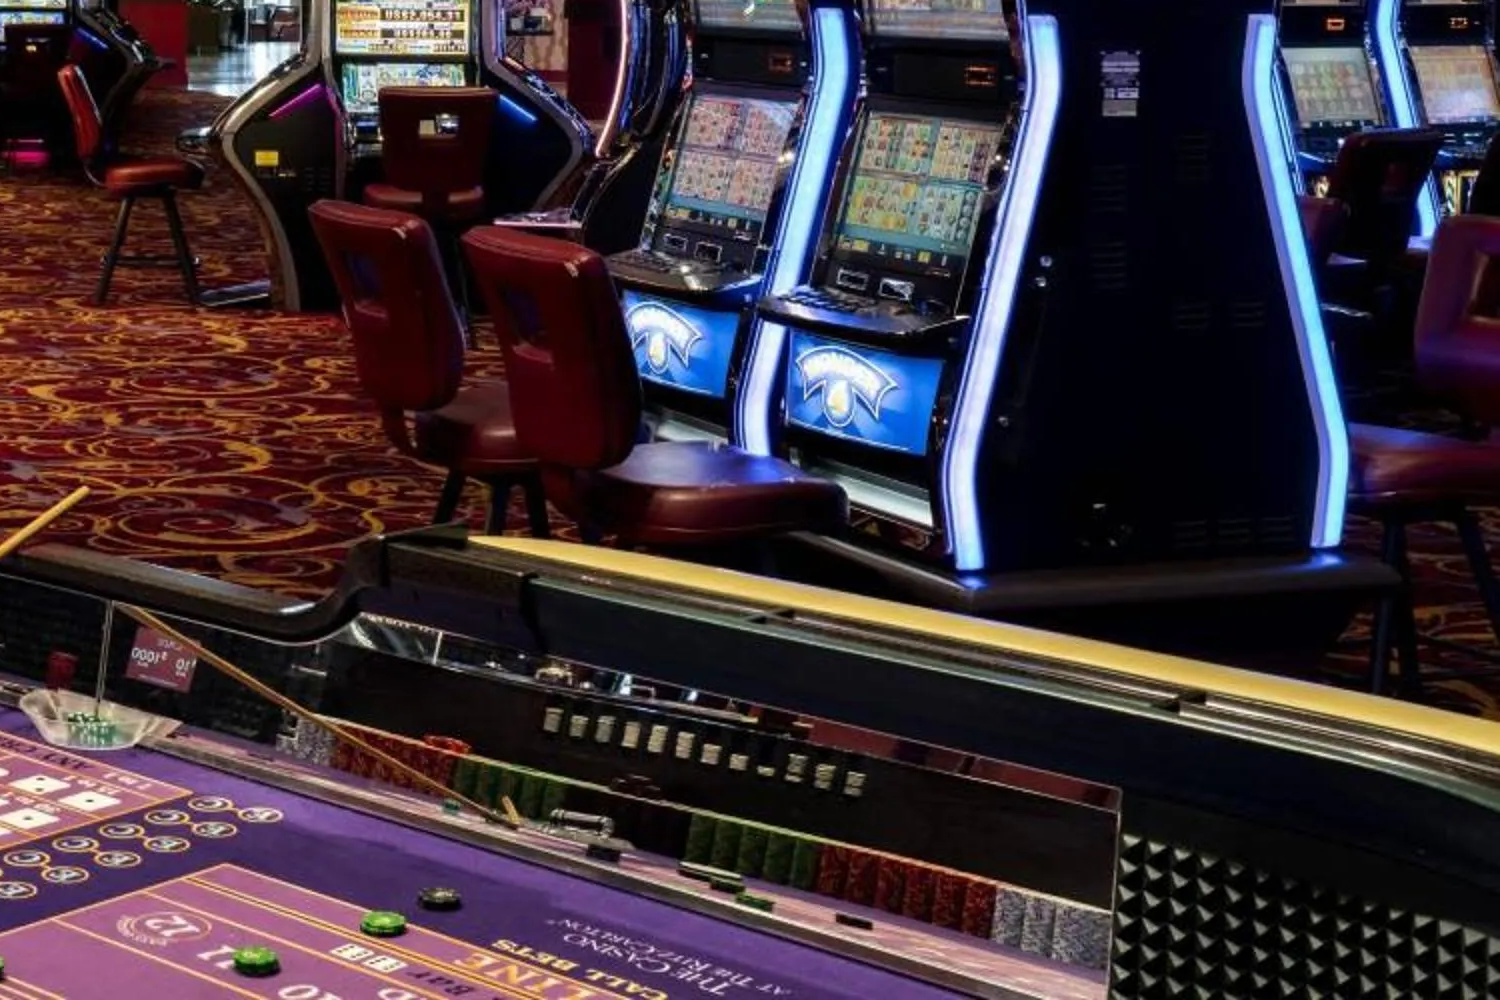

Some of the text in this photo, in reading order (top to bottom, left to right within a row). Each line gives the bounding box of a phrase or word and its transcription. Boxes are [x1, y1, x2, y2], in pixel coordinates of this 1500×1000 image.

[146, 915, 200, 939] 12
[492, 939, 578, 970] BETS
[564, 933, 669, 974] CASINO
